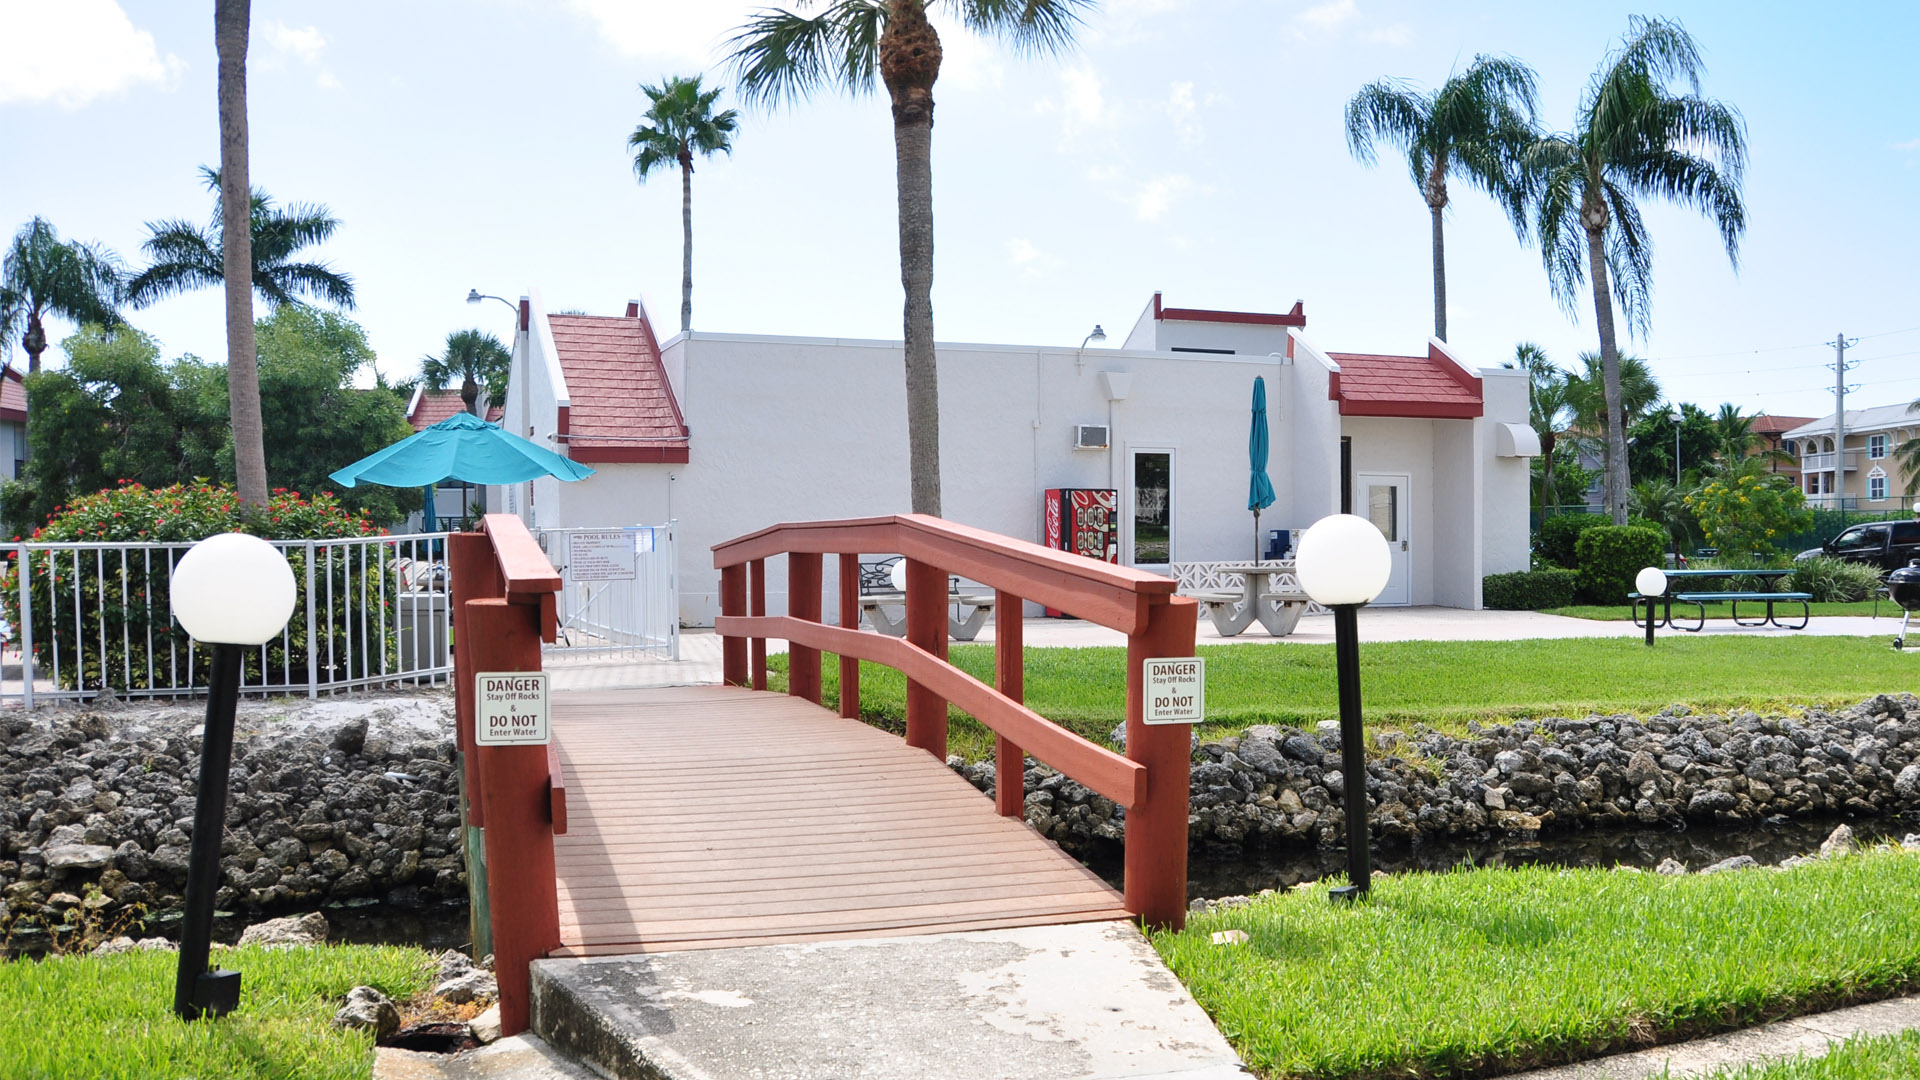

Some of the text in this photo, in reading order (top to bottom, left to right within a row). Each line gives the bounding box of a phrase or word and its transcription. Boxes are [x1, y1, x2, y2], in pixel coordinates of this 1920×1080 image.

[1153, 664, 1196, 676] DANGER
[487, 679, 540, 692] DANGER
[1152, 677, 1167, 685] Stay
[486, 692, 540, 702] Stay Off Rocks
[1155, 696, 1194, 708] DO NOT
[510, 704, 517, 712] &
[490, 715, 537, 727] DO NOT
[513, 728, 537, 736] Water
